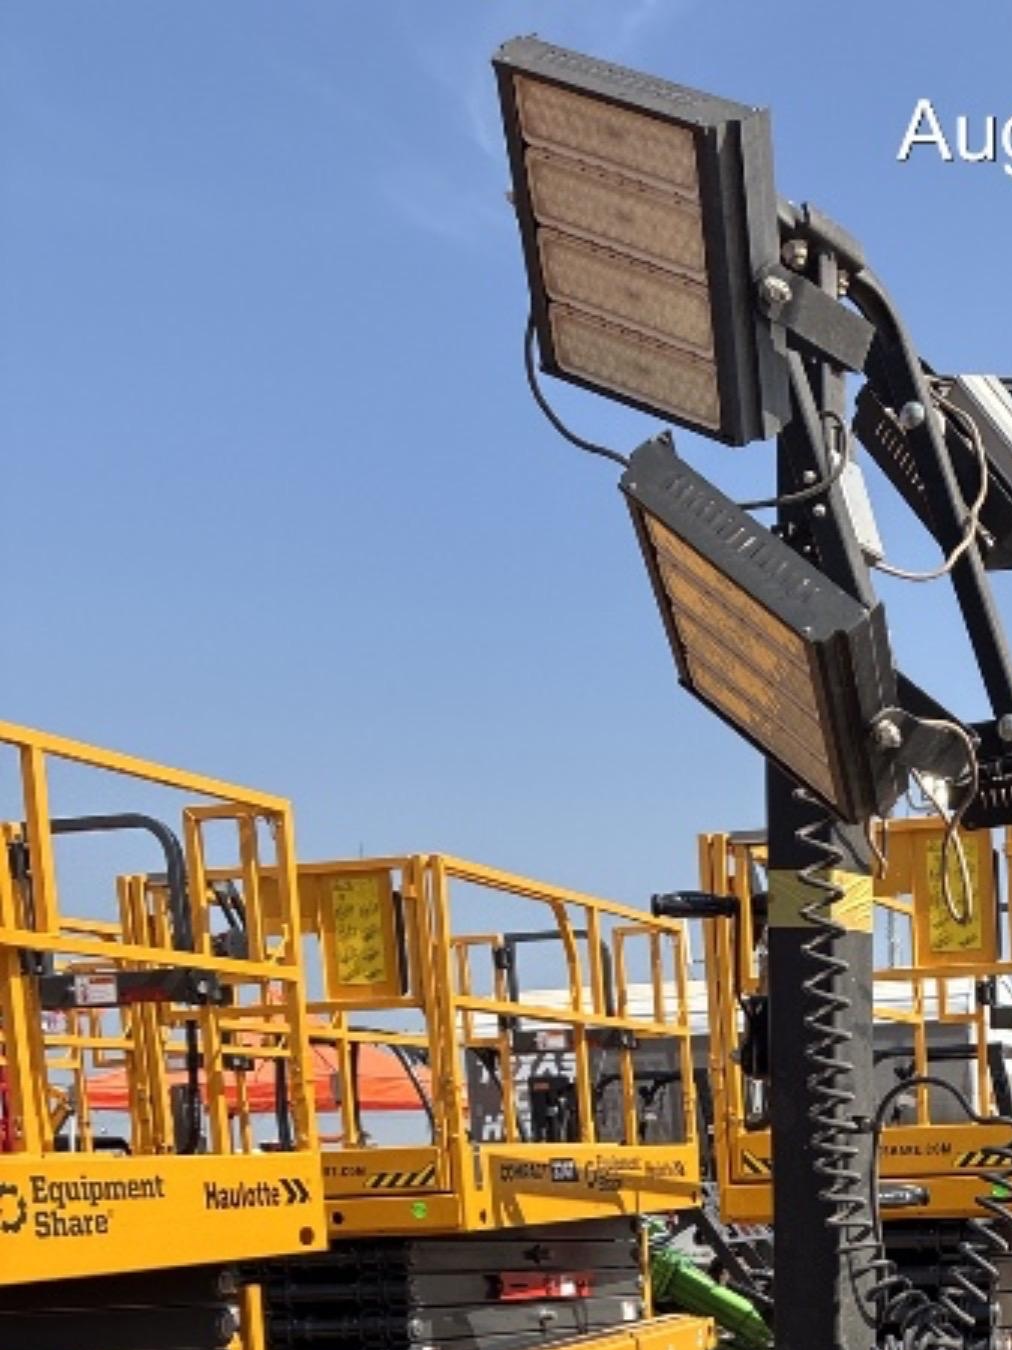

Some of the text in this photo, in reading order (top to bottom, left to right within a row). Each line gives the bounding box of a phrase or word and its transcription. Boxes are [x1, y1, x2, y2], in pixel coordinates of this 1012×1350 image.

[29, 1174, 166, 1210] Equipment
[203, 1180, 282, 1210] Haulotte
[34, 1210, 110, 1240] Share
